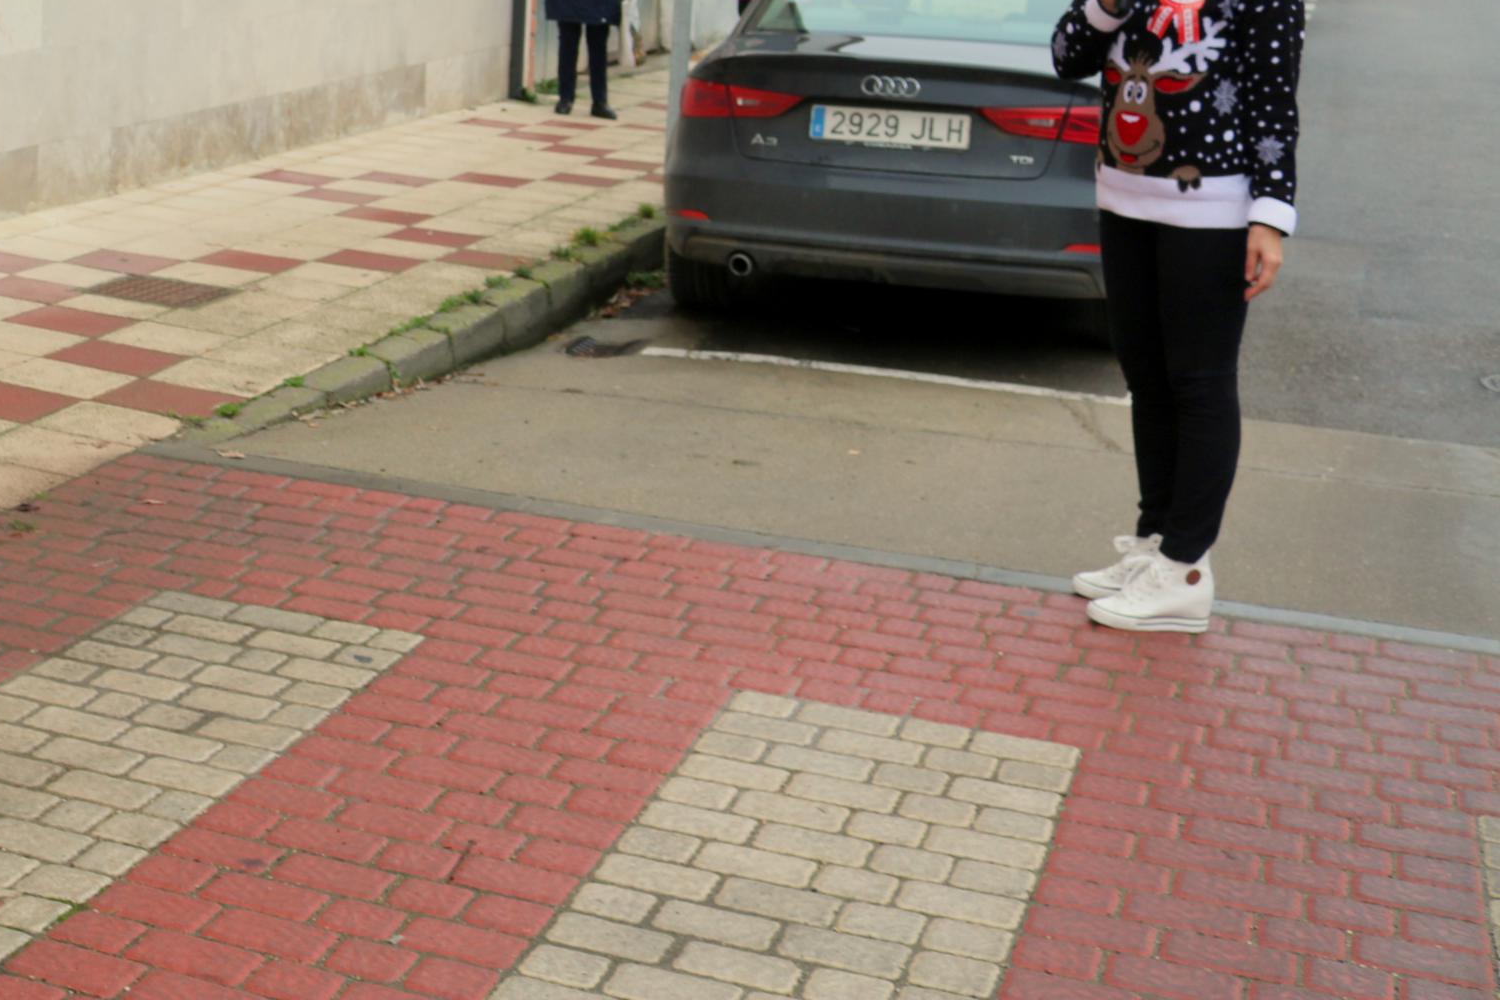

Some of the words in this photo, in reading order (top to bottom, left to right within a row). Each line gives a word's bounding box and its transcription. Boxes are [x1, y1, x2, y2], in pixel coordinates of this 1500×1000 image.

[830, 110, 899, 138] 2929
[910, 116, 963, 143] JLH
[750, 132, 779, 147] A3
